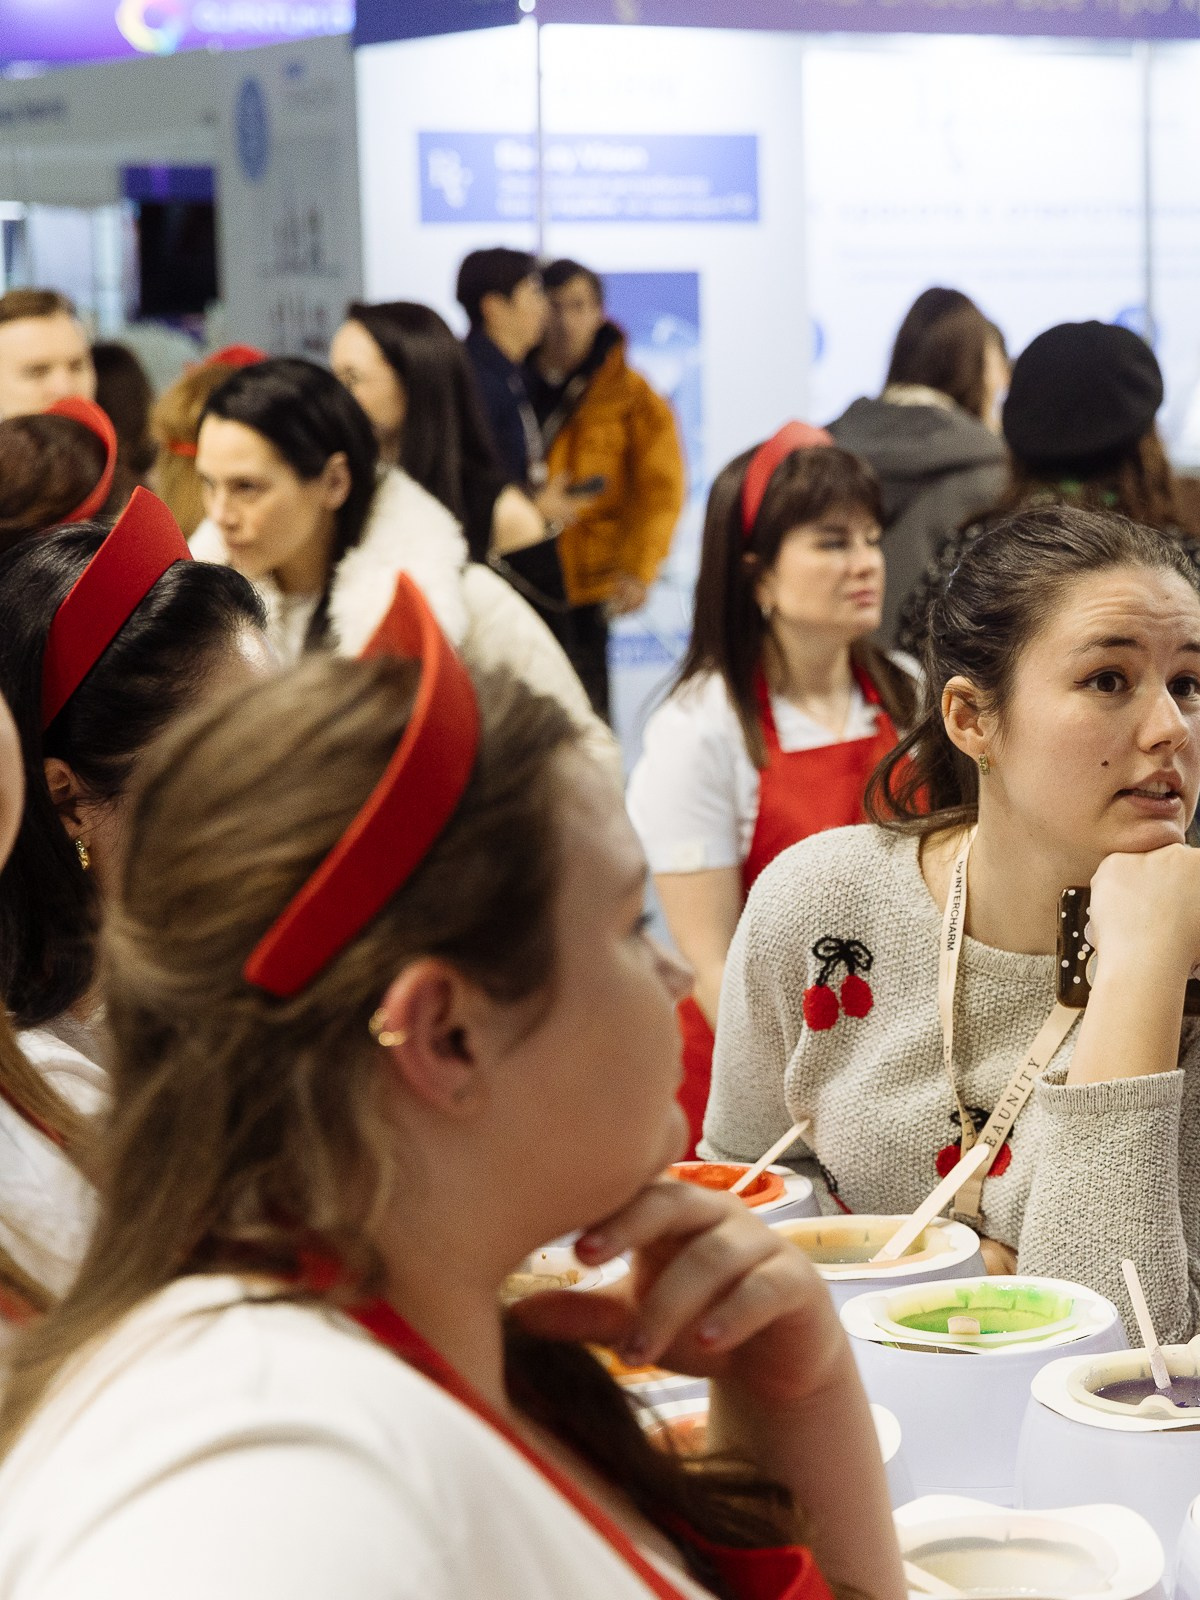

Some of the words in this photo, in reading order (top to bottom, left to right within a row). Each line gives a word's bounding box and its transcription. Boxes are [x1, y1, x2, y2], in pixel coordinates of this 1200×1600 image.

[955, 860, 965, 875] by
[946, 876, 962, 952] INTERCHARM
[984, 1057, 1040, 1158] EAUNITY
